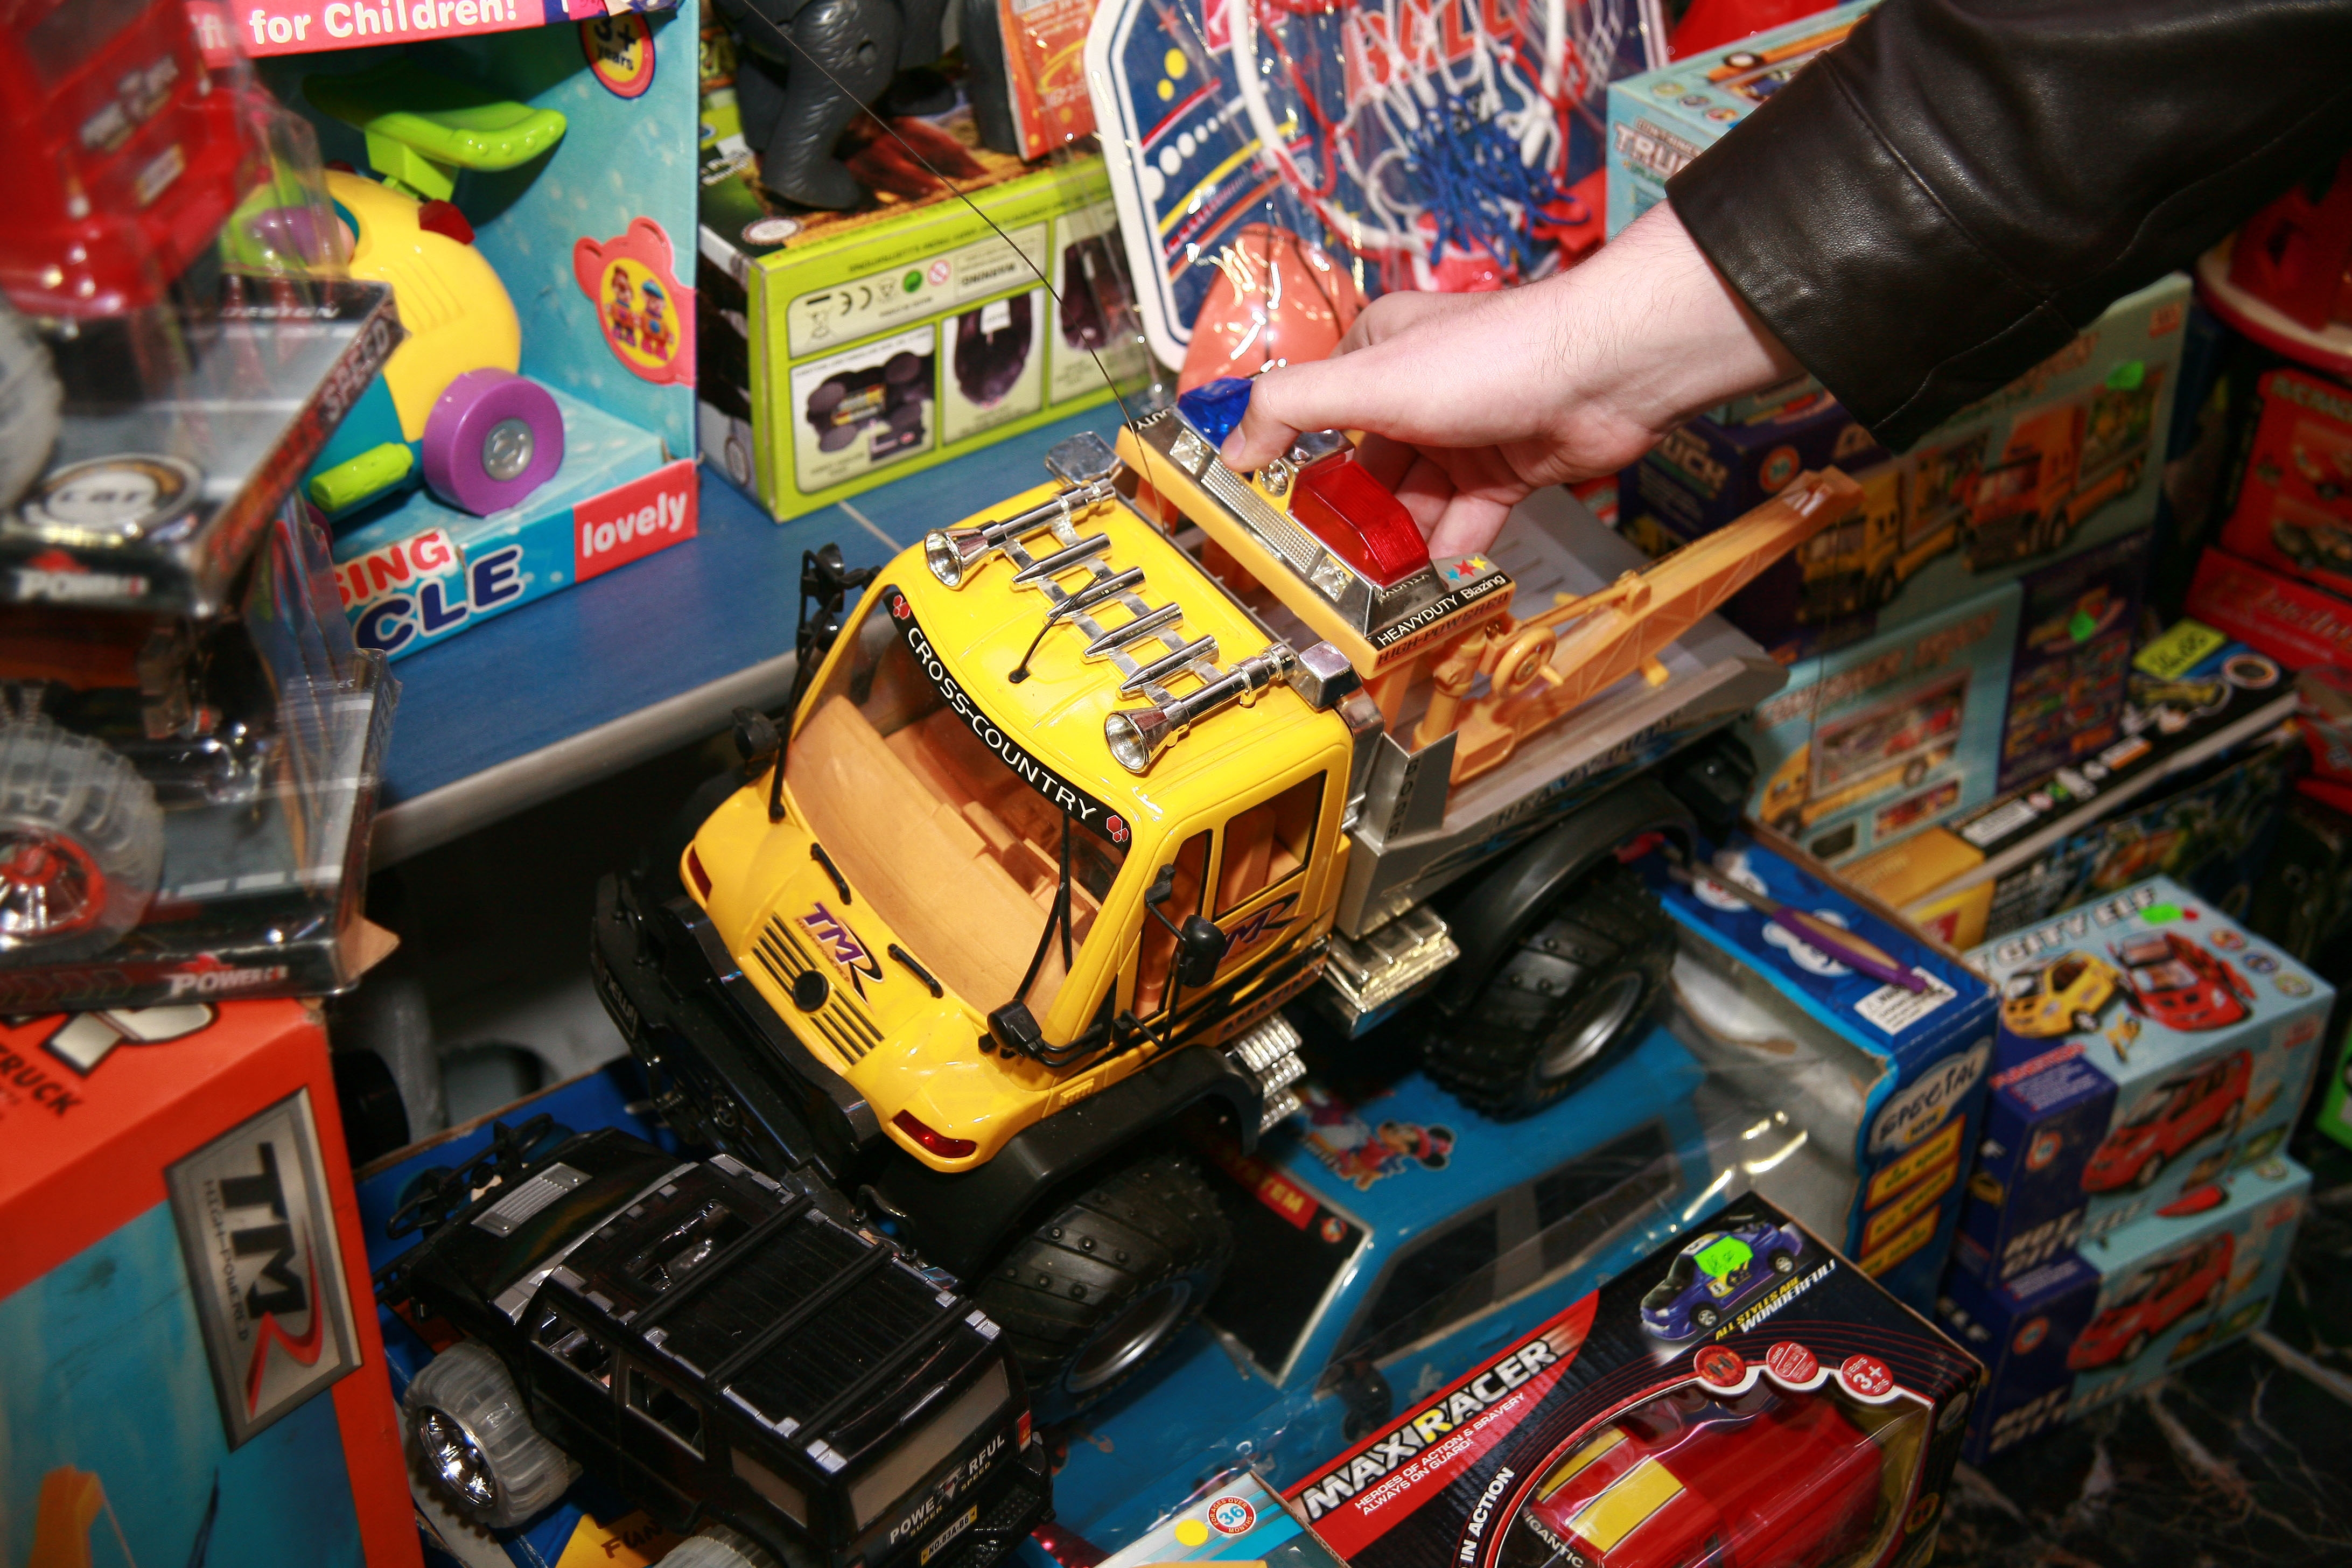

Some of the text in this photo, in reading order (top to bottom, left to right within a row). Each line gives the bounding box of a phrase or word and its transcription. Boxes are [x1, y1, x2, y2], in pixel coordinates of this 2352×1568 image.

[249, 10, 311, 45] for
[324, 0, 517, 38] Children!
[582, 491, 688, 558] lovely
[1376, 594, 1458, 646] HEAVYDUTY
[1460, 575, 1506, 600] Blazing
[907, 627, 1096, 821] CROSS-COUNTRY
[803, 902, 884, 1013] TMR
[218, 1140, 324, 1420] TMR
[1716, 1320, 1738, 1341] ALL
[1852, 1364, 1883, 1390] 3+
[1355, 1392, 1525, 1509] HEROES OF ACTION & BRAVERY
[1363, 1438, 1474, 1515] ALWAYS ON GUARD!
[910, 1461, 991, 1537] SUPER SPEED
[1209, 1498, 1248, 1527] FOR AGES OVER
[1218, 1505, 1245, 1525] 36
[1228, 1515, 1254, 1534] MONTHS
[1460, 1466, 1516, 1563] IN ACTION
